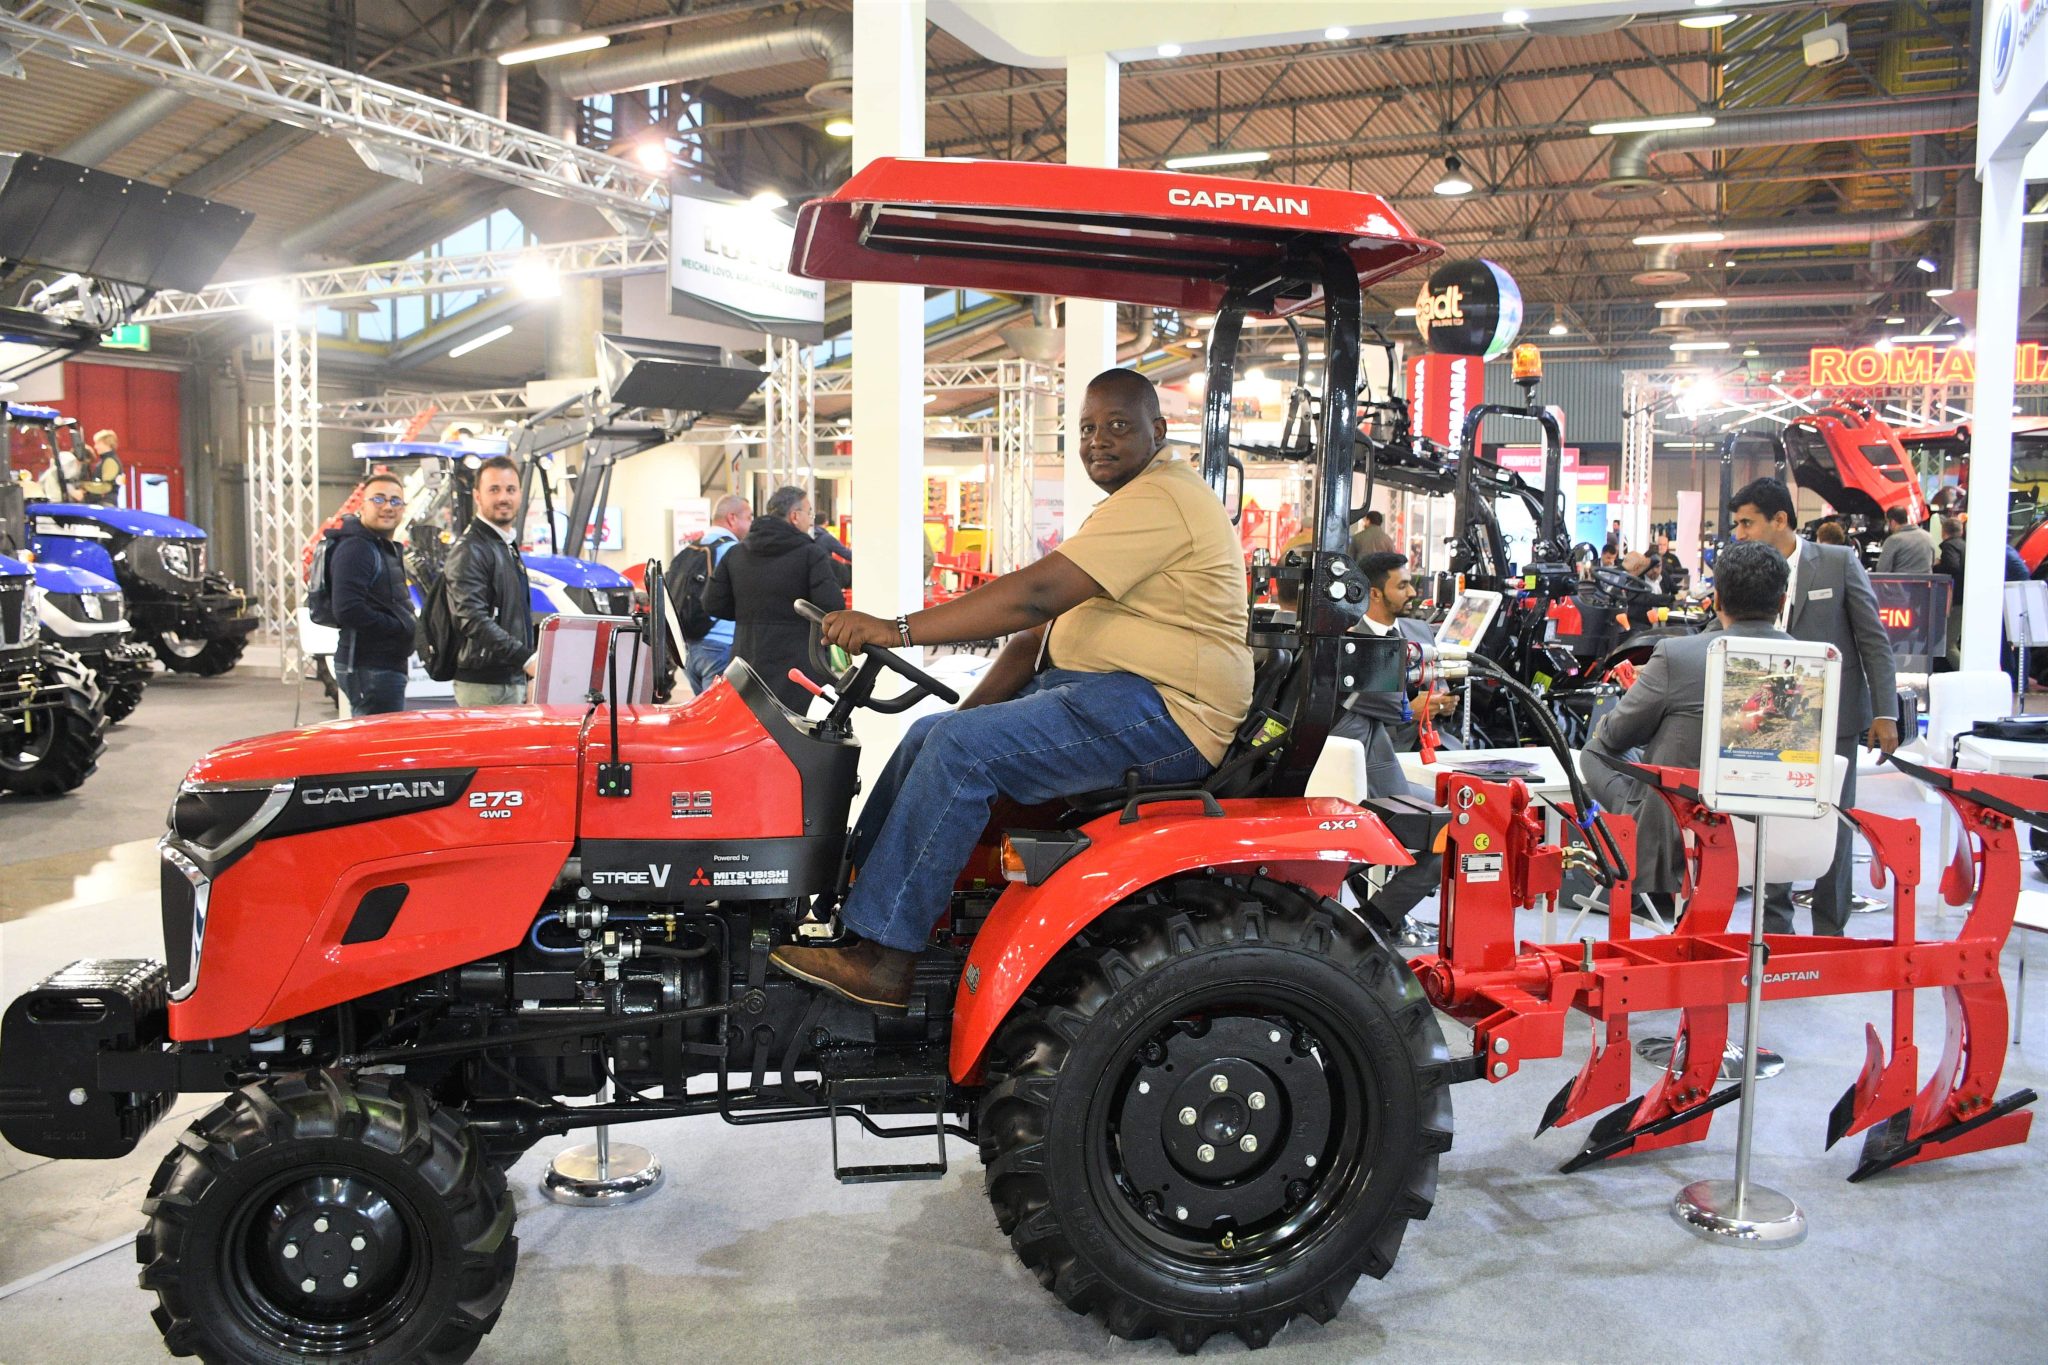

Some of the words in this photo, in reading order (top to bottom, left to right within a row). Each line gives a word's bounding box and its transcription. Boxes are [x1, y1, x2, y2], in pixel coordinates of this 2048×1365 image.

[1168, 188, 1309, 216] CAPTAIN
[1810, 342, 2048, 386] ROMAI
[302, 780, 445, 805] CAPTAIN
[469, 791, 523, 808] 273
[479, 810, 512, 819] 4WD
[713, 854, 738, 862] Powered
[739, 854, 750, 862] by
[713, 870, 789, 880] MITSUBISHI
[1763, 970, 1819, 983] CAPTAIN
